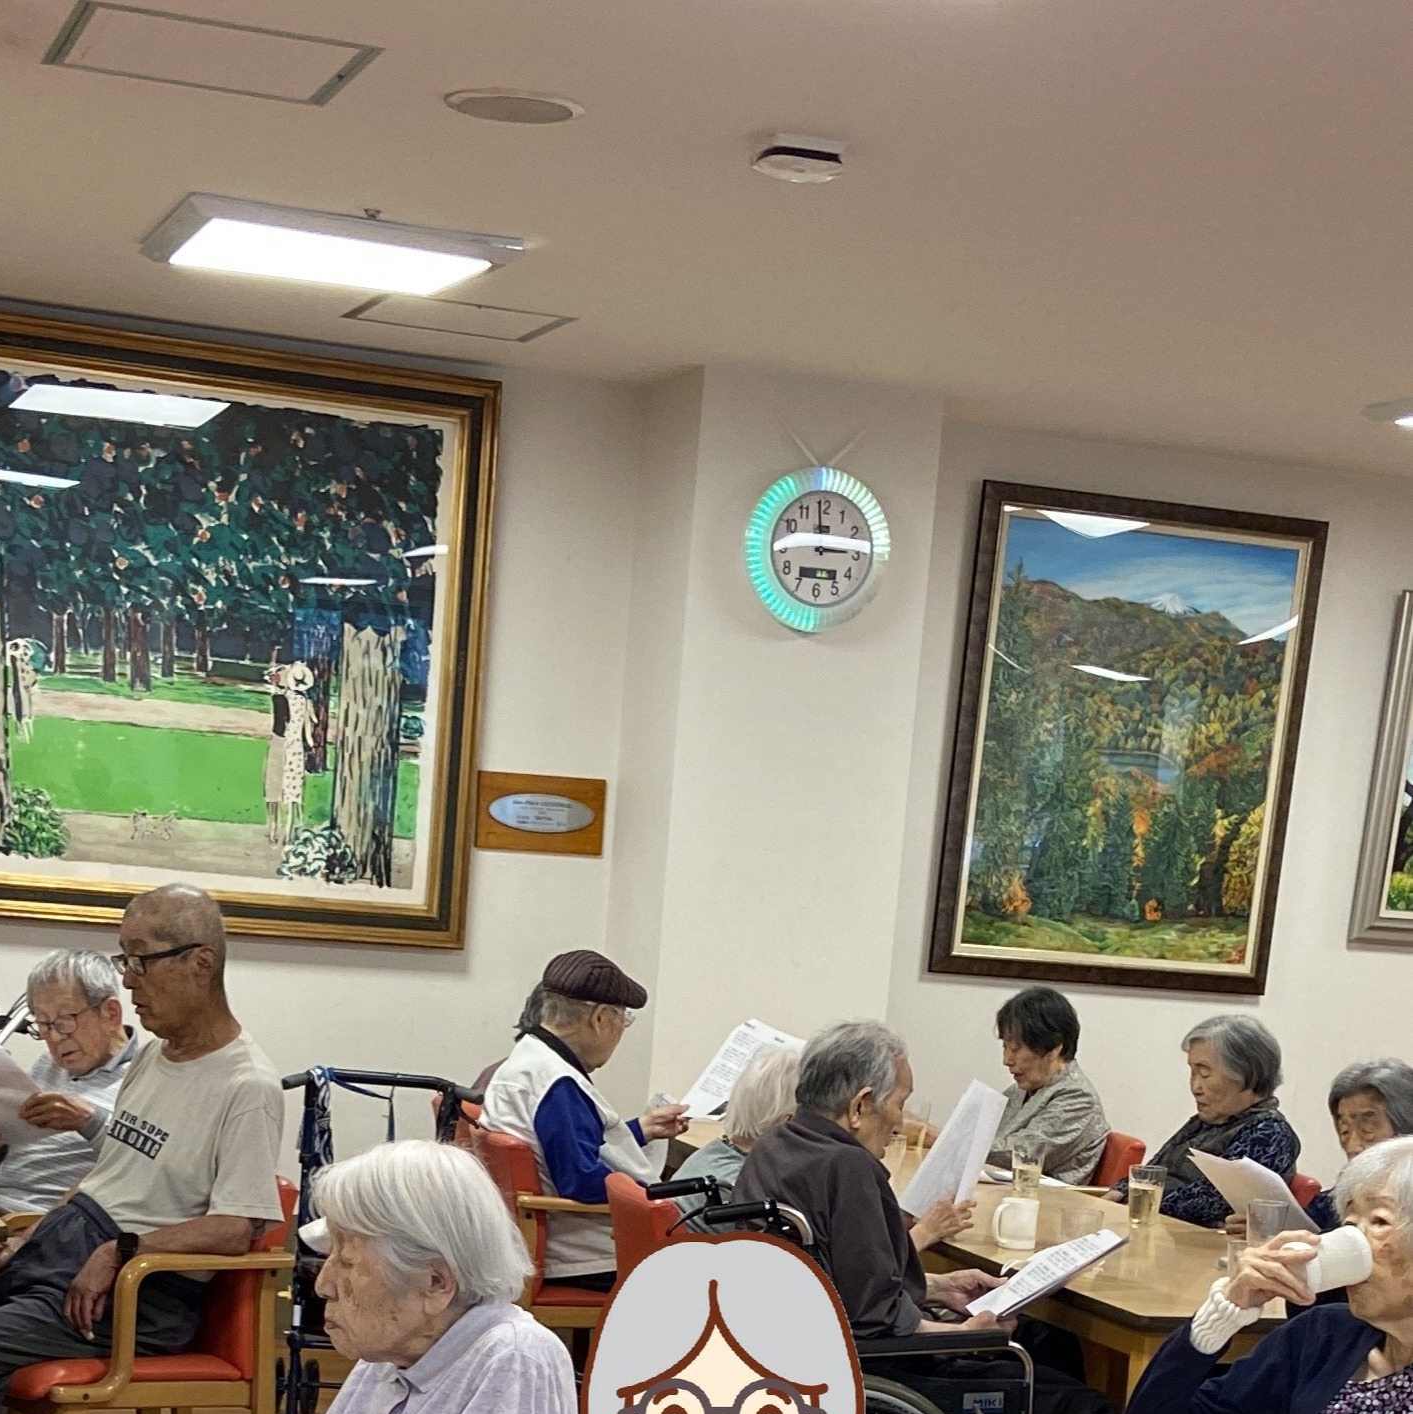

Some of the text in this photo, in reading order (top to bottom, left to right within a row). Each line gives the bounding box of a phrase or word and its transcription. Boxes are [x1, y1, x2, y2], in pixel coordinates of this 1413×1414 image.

[798, 505, 809, 519] 11
[817, 499, 831, 515] 12
[839, 510, 845, 524] 1
[785, 519, 797, 533] 10
[850, 526, 859, 539] 2
[782, 560, 791, 575] 8
[843, 566, 852, 580] 4
[795, 577, 803, 591] 7
[812, 583, 821, 598] 6
[830, 581, 839, 595] 5
